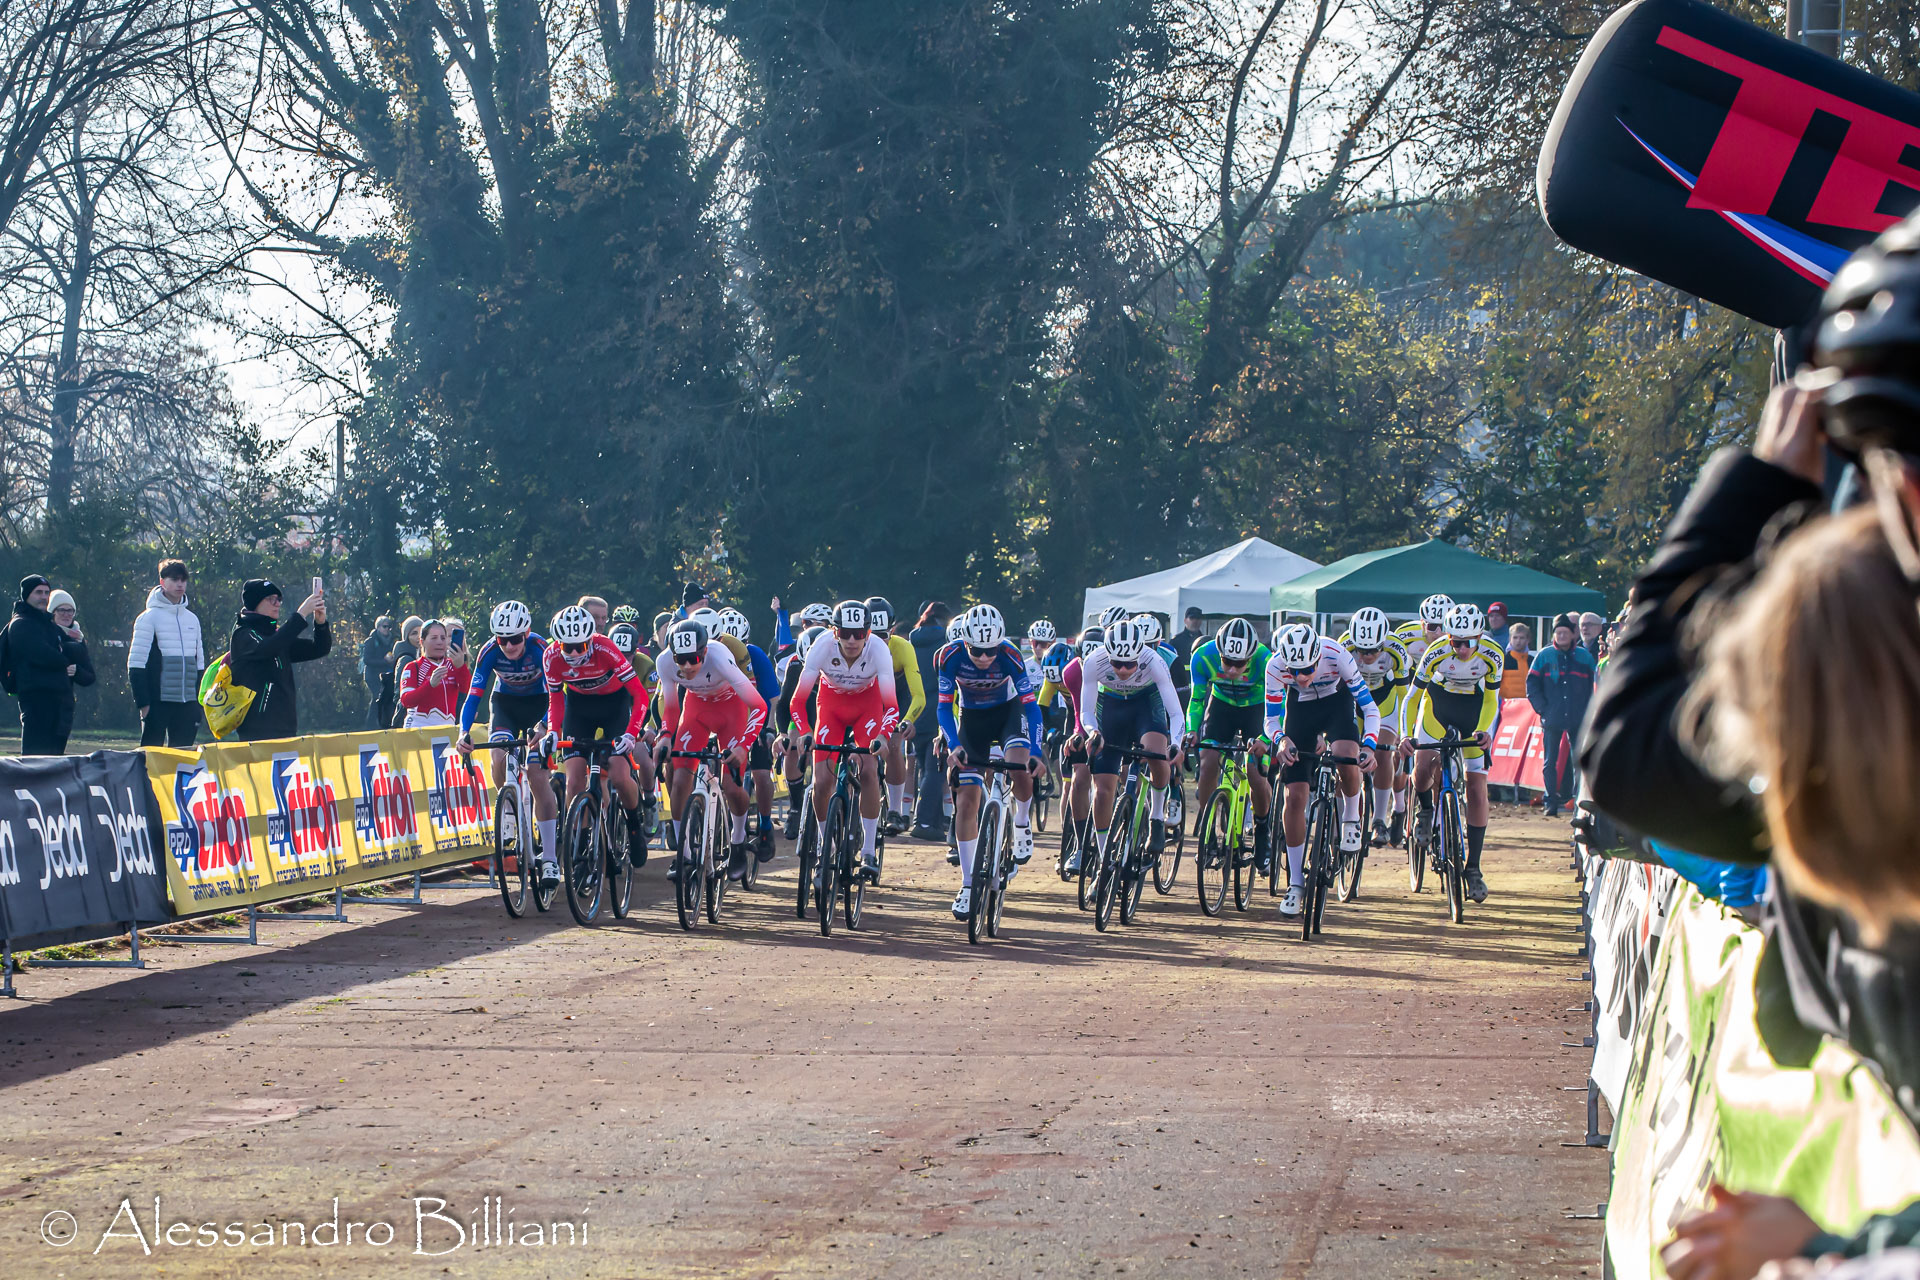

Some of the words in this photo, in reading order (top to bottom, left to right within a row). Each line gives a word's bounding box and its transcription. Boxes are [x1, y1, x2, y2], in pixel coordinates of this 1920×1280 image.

[498, 614, 511, 627] 21
[847, 609, 860, 623] 16
[872, 614, 884, 627] 41
[1431, 607, 1443, 620] 34
[1455, 616, 1469, 629] 23
[568, 623, 580, 637] 19
[979, 629, 992, 642] 17
[1360, 626, 1372, 639] 31
[616, 635, 628, 647] 42
[678, 633, 691, 647] 18
[1228, 639, 1242, 654] 30
[1116, 643, 1130, 657] 22
[1290, 647, 1305, 662] 24
[1422, 647, 1446, 668] MICHE
[430, 796, 442, 815] PRO
[356, 806, 370, 828] PRO
[269, 819, 285, 842] PRO
[169, 832, 191, 855] PRO
[216, 880, 233, 897] PER
[233, 877, 245, 894] LO
